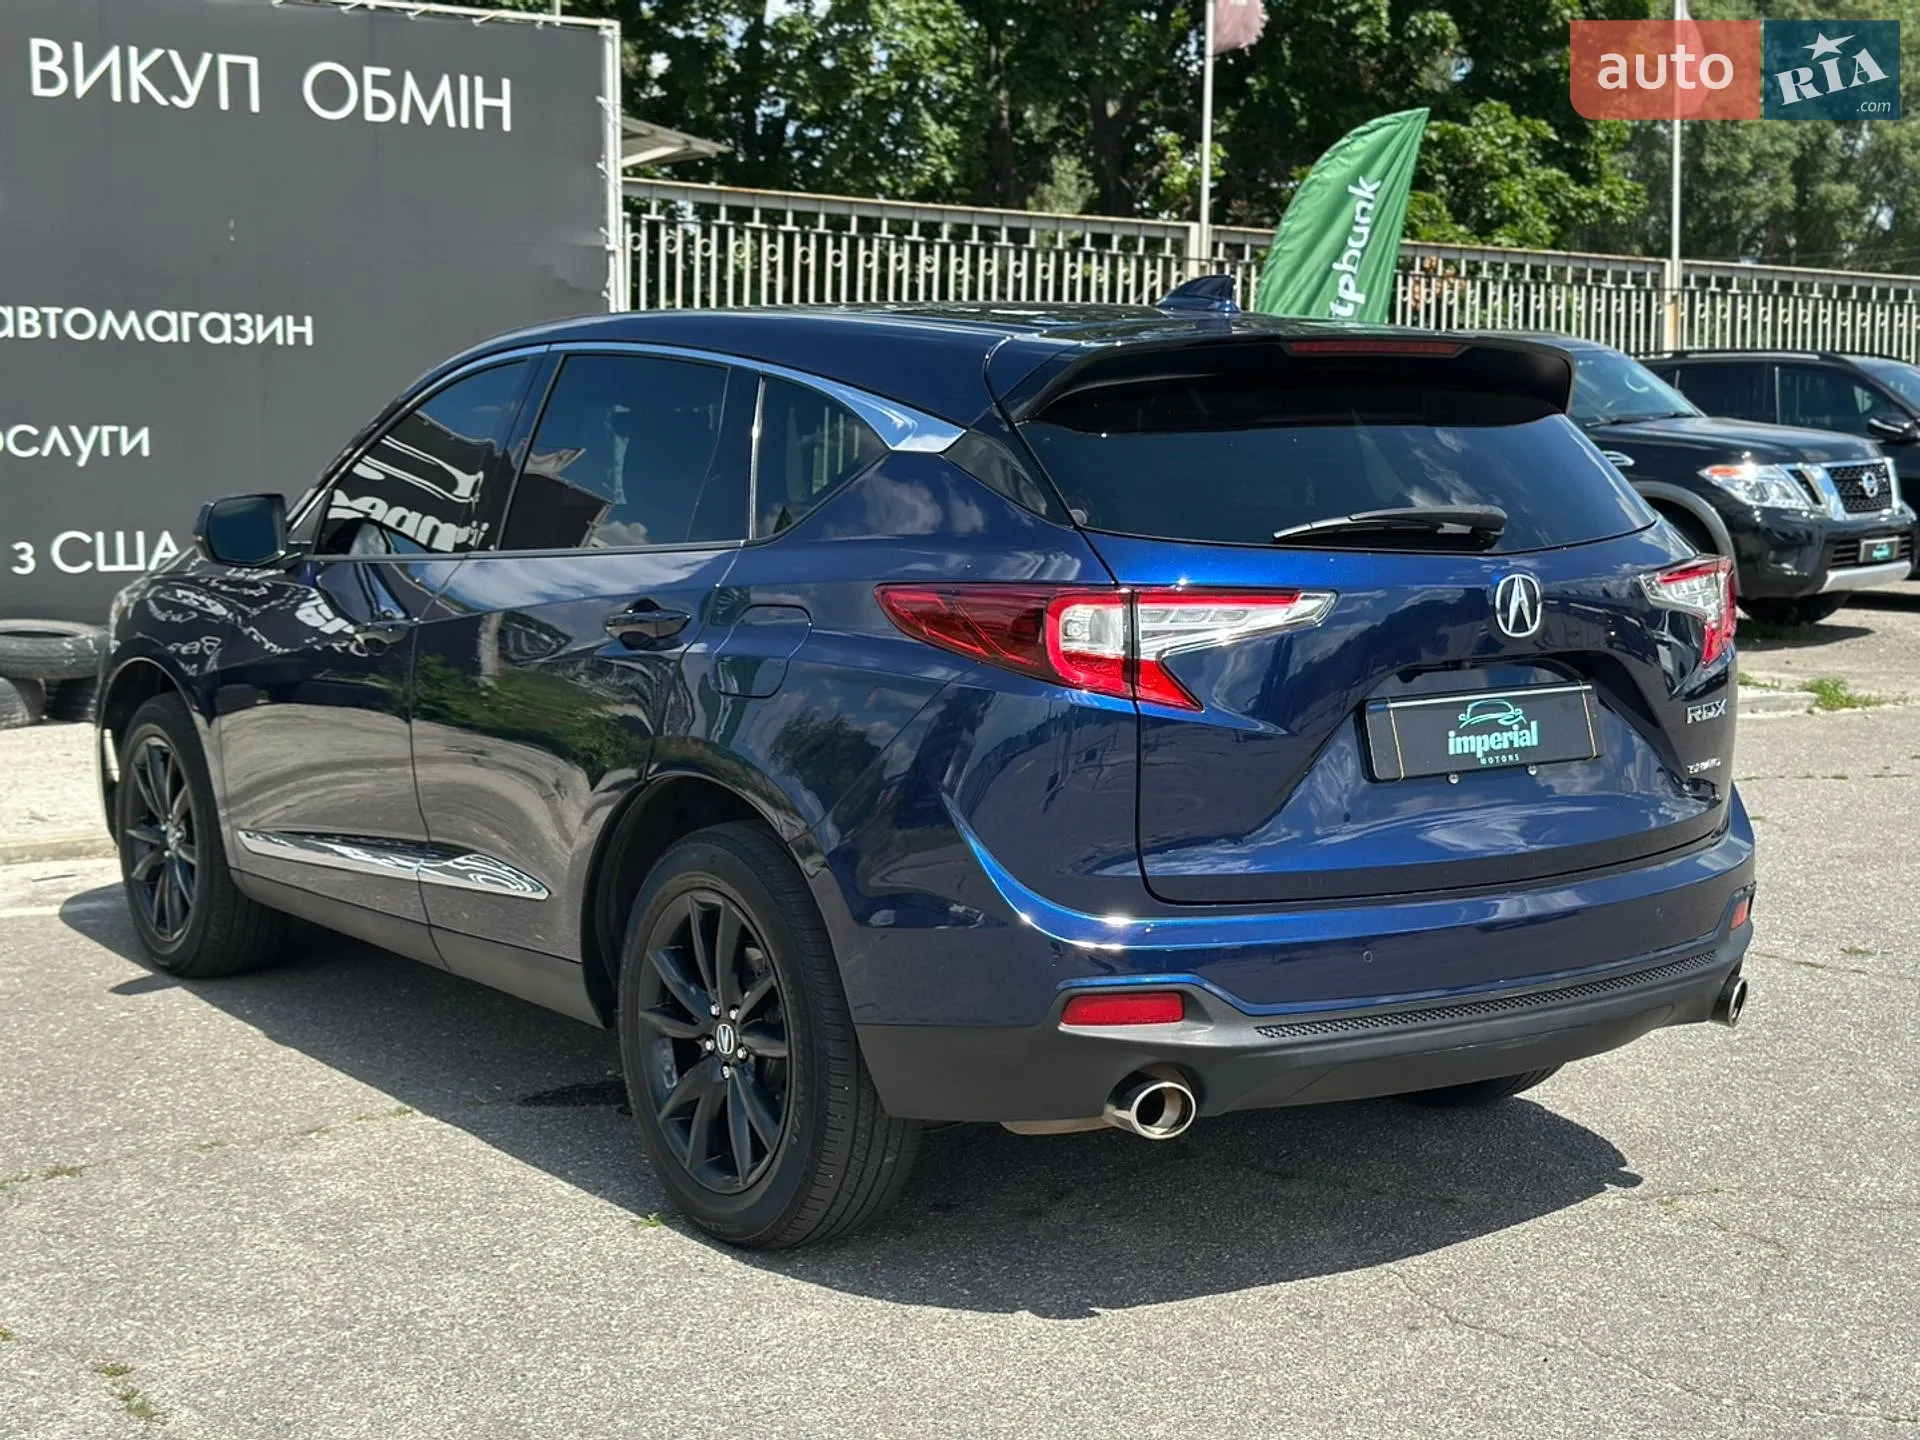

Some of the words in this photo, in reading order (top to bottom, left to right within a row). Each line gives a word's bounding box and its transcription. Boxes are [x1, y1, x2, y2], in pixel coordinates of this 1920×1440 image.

[30, 38, 260, 113] ВИКУП
[303, 61, 511, 132] ОБМІН
[0, 424, 149, 467] слуги
[12, 542, 36, 574] з
[51, 530, 180, 574] США
[1448, 720, 1538, 759] imperial
[1480, 753, 1520, 765] MOTORS
